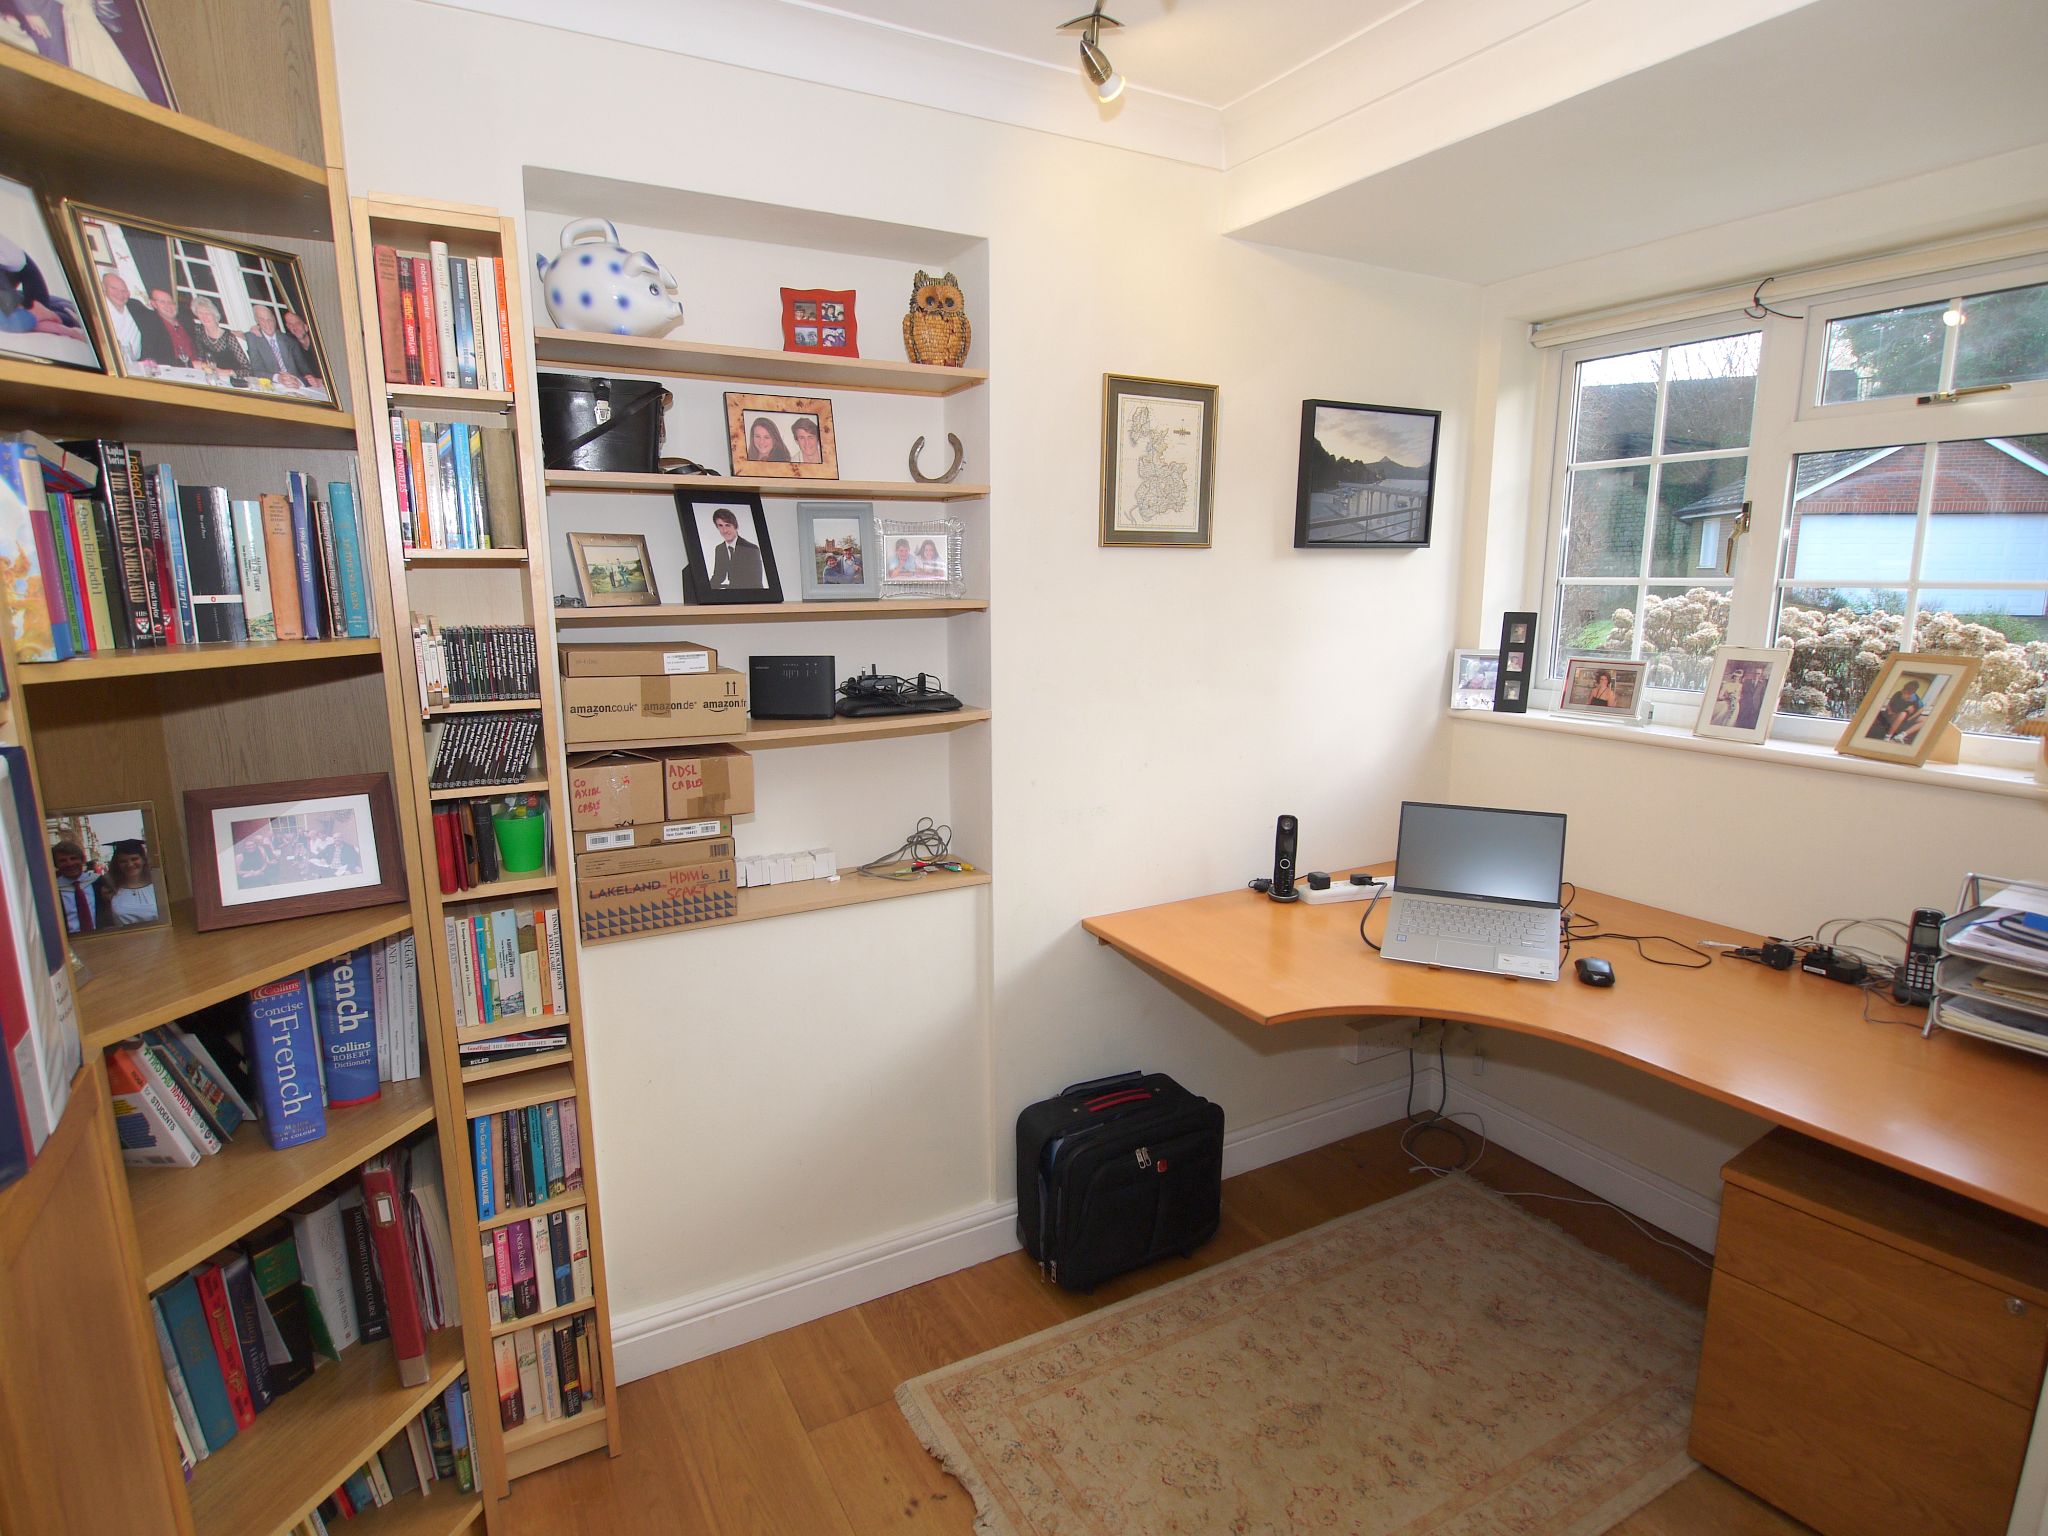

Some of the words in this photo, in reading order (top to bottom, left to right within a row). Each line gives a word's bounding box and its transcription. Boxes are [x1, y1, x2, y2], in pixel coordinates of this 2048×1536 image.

[420, 263, 428, 285] robert
[422, 295, 430, 319] parker
[110, 471, 129, 491] THE
[129, 456, 145, 498] naked
[398, 461, 407, 492] ANGELES
[114, 495, 136, 543] BALANCED
[135, 499, 149, 540] leader
[149, 497, 160, 539] MEASURING
[79, 507, 91, 540] Queen
[85, 544, 101, 590] Elizabeth
[121, 547, 146, 603] SCORECARD
[302, 563, 311, 583] DIARY
[149, 581, 157, 598] david
[150, 600, 159, 618] taylor
[669, 764, 698, 778] ADSL
[589, 880, 661, 899] LAKELAND
[447, 924, 455, 942] JOHN
[388, 947, 397, 966] ONEY
[404, 936, 414, 969] NEGAR
[448, 944, 457, 965] KEATS
[376, 967, 384, 984] Soda
[264, 982, 299, 995] Collins
[332, 951, 369, 1034] rench
[254, 1001, 304, 1018] Concise
[331, 1041, 371, 1054] Collins
[333, 1050, 370, 1062] ROBERT
[270, 1012, 312, 1117] French
[334, 1058, 372, 1069] Dictionary
[149, 1054, 165, 1076] FIRST
[161, 1073, 175, 1088] AID
[170, 1085, 194, 1117] MANUAL
[150, 1096, 176, 1131] STUDENTS
[551, 1120, 559, 1146] ROBYN
[553, 1147, 561, 1168] CARR
[358, 1232, 368, 1262] COMPLETE
[516, 1233, 524, 1249] Nora
[517, 1250, 526, 1275] Roberts
[362, 1263, 372, 1293] COOKERY
[336, 1288, 346, 1305] JANE
[366, 1294, 376, 1317] COURSE
[340, 1307, 350, 1329] DUNN
